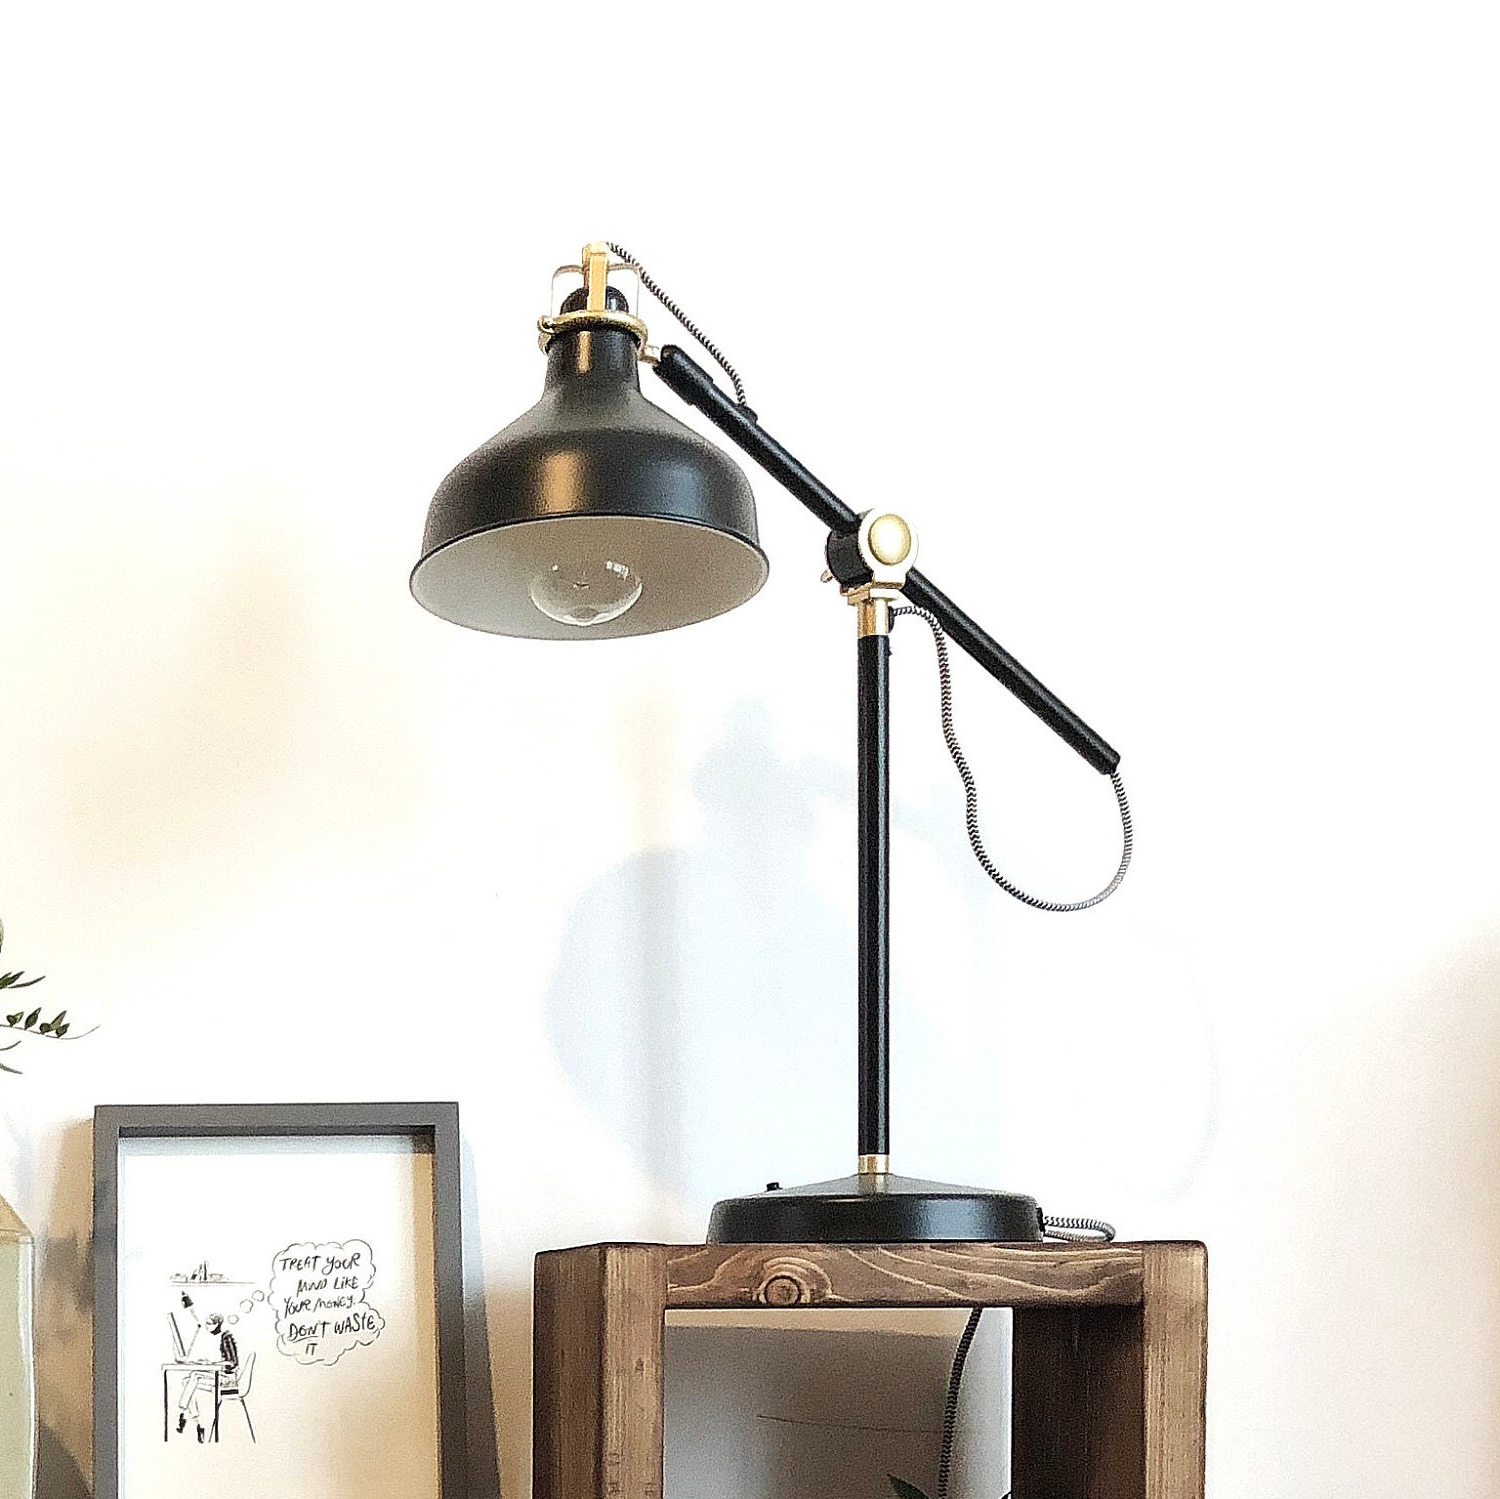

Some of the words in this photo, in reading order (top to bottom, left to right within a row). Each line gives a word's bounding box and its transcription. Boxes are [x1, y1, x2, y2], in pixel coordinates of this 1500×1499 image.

[279, 1256, 321, 1271] TREAT
[321, 1253, 360, 1275] YOUR
[284, 1296, 311, 1319] YOUR
[306, 1343, 318, 1355] IT
